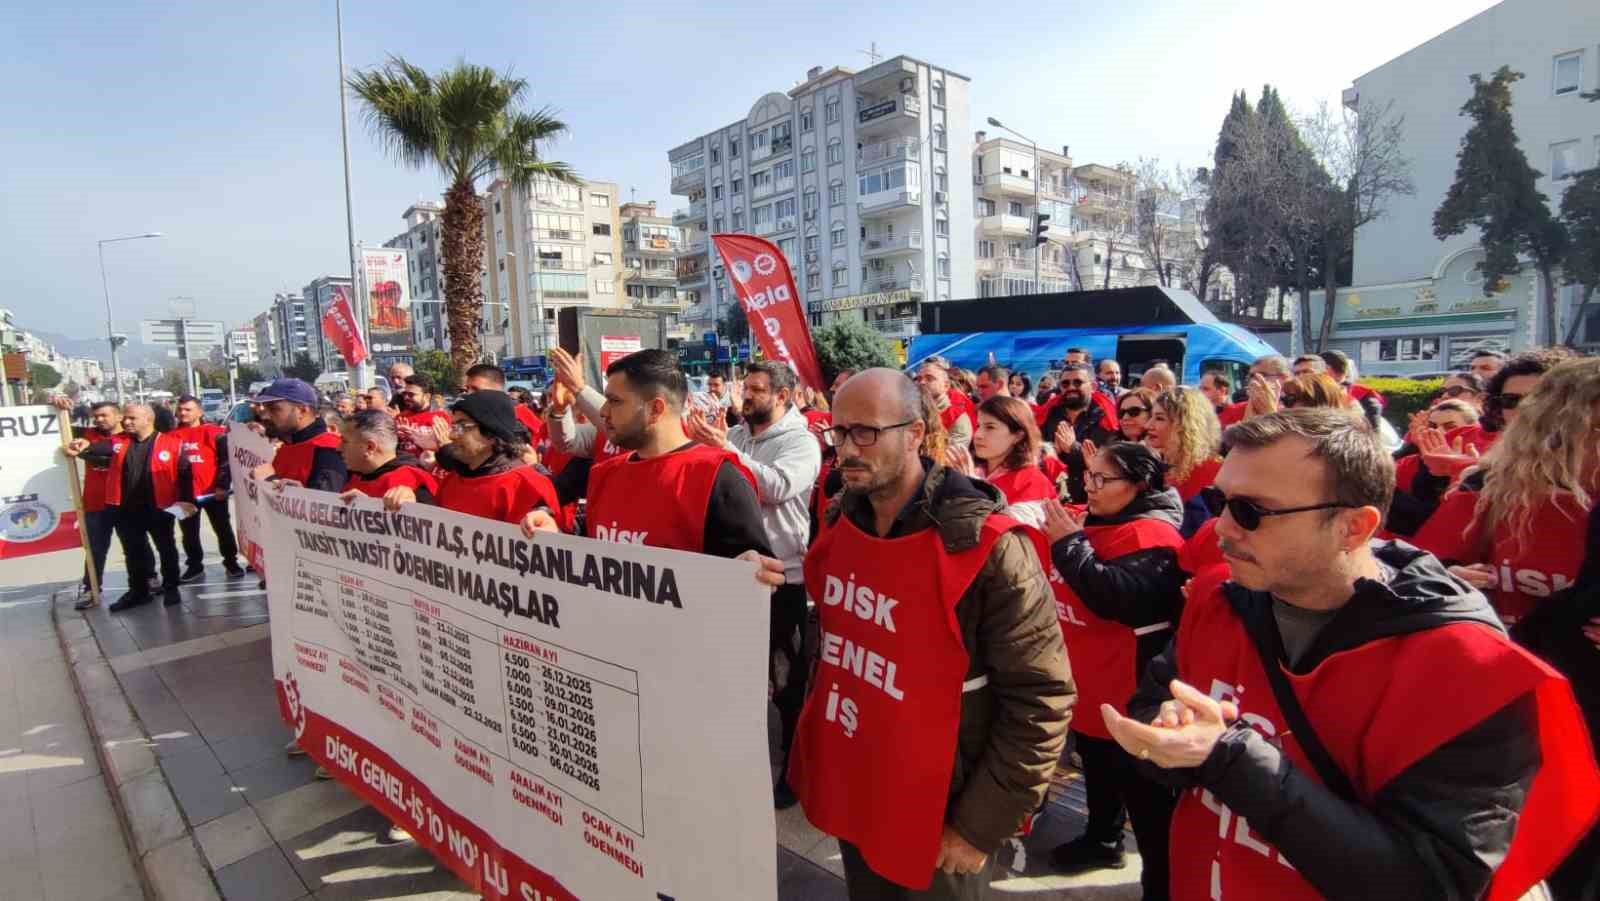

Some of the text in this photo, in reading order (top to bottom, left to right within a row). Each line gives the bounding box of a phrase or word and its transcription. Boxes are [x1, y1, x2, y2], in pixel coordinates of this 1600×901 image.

[294, 528, 561, 629] TAKSİT TAKSİT ÖDENEN MAAŞLAR
[391, 511, 433, 546] KENT
[471, 530, 683, 609] ÇALIŞANLARINA
[823, 572, 899, 633] DİSK
[821, 631, 905, 701] ENEL
[825, 682, 859, 738] İŞ
[325, 735, 359, 776] DİSK
[361, 757, 425, 829] GENEL-İŞ
[426, 807, 444, 843] 10
[511, 770, 562, 808] ARALIK AYI
[582, 811, 634, 853] OCAK AYI
